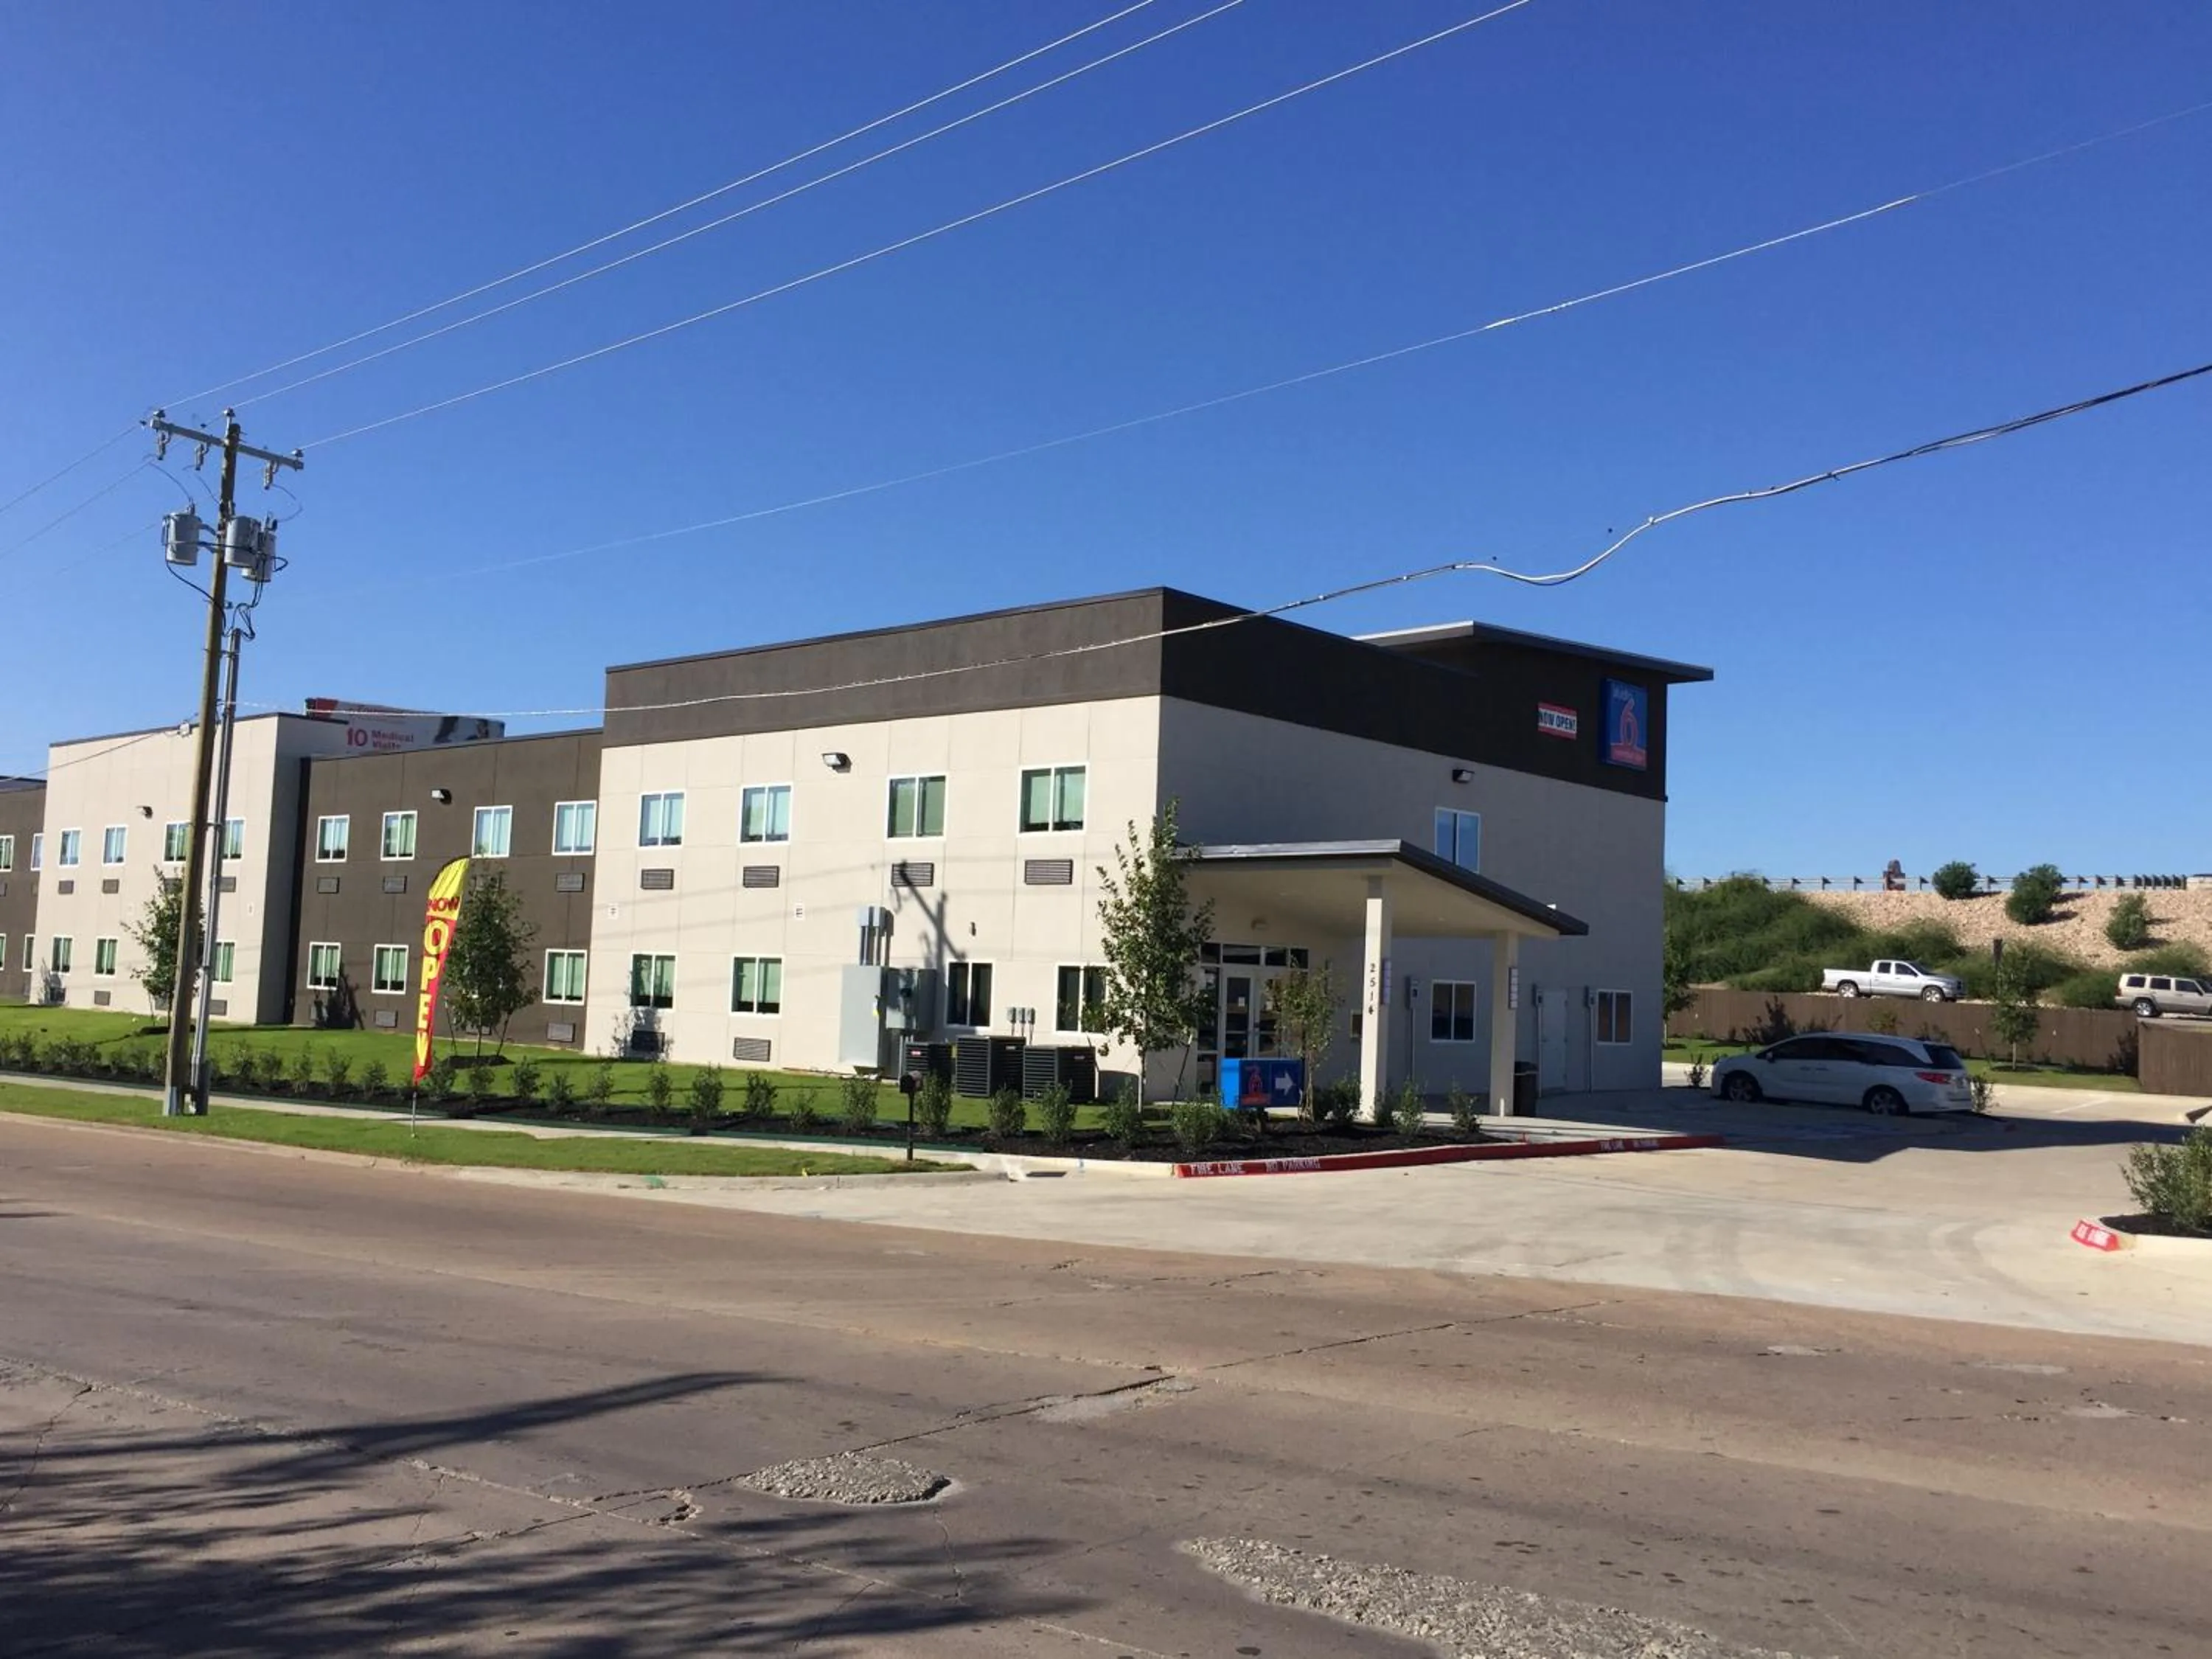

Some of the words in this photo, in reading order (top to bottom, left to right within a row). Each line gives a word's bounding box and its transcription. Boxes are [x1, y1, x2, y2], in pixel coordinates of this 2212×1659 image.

[1539, 710, 1554, 726] NOW
[347, 727, 368, 747] 10
[371, 729, 414, 743] Medical
[426, 897, 461, 911] NOW
[1368, 962, 1377, 1015] 2514
[1190, 1163, 1214, 1175] FIRE
[1218, 1162, 1246, 1175] LANE
[1265, 1161, 1278, 1173] NO
